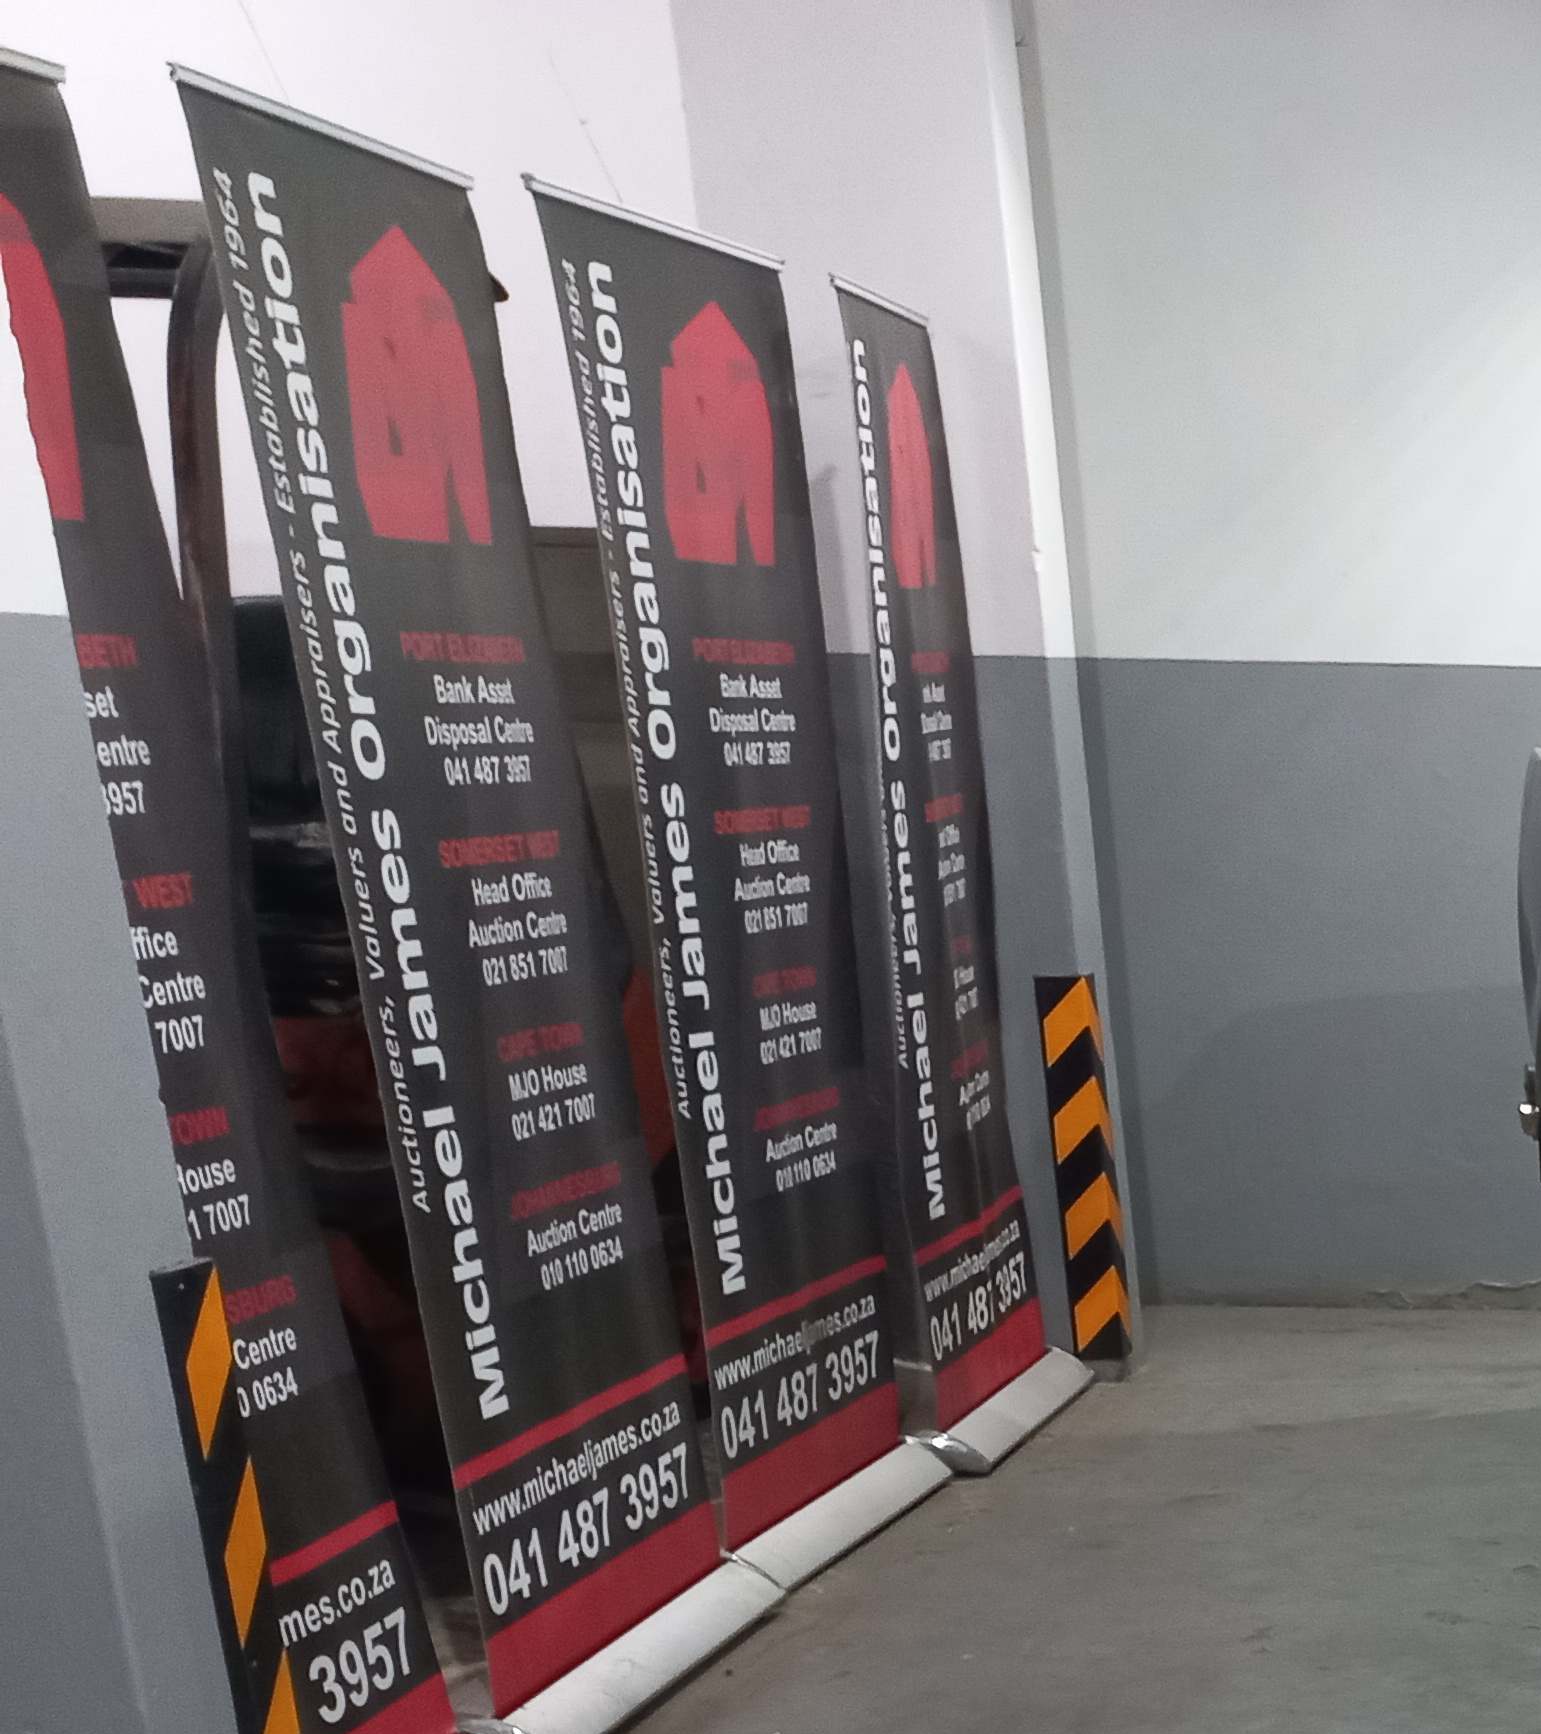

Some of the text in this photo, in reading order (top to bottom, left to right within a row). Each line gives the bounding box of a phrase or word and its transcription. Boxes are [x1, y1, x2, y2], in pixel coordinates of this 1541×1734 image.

[213, 167, 249, 270] 1964
[233, 281, 297, 514] Established
[852, 338, 901, 762] Organisation
[291, 551, 343, 754] Appraisers
[82, 685, 119, 718] set
[433, 673, 475, 704] Bank
[423, 714, 492, 750] Disposal
[708, 706, 759, 737] Disposal
[97, 734, 151, 767] entre
[443, 757, 472, 786] 041
[474, 756, 501, 784] 487
[587, 261, 747, 1296] Michael James Organisation
[248, 171, 511, 1420] Michael James Organisation
[328, 761, 357, 835] and
[471, 871, 553, 907] Head Office
[890, 779, 922, 977] James
[348, 847, 386, 980] Valuers
[468, 910, 568, 949] Auction Centre
[130, 926, 179, 960] ffice
[482, 956, 507, 987] 021
[510, 951, 537, 983] 851
[155, 1013, 205, 1053] 7007
[659, 937, 692, 1120] Auctioneers,
[379, 995, 431, 1213] Auctioneers,
[508, 1062, 589, 1102] MJO House
[906, 991, 947, 1222] Michael
[511, 1092, 597, 1142] 021 421 7007
[203, 1193, 251, 1236] 7007
[527, 1202, 624, 1258] Auction Centre
[540, 1234, 624, 1291] 010 110 0634
[232, 1325, 298, 1371] Centre
[930, 1302, 962, 1361] 041
[252, 1365, 299, 1412] 0634
[721, 1329, 880, 1459] 041 487 3957
[472, 1400, 682, 1536] www.michaeljames.co.za
[483, 1441, 690, 1616] 041 487 3957
[308, 1605, 413, 1725] 3957
